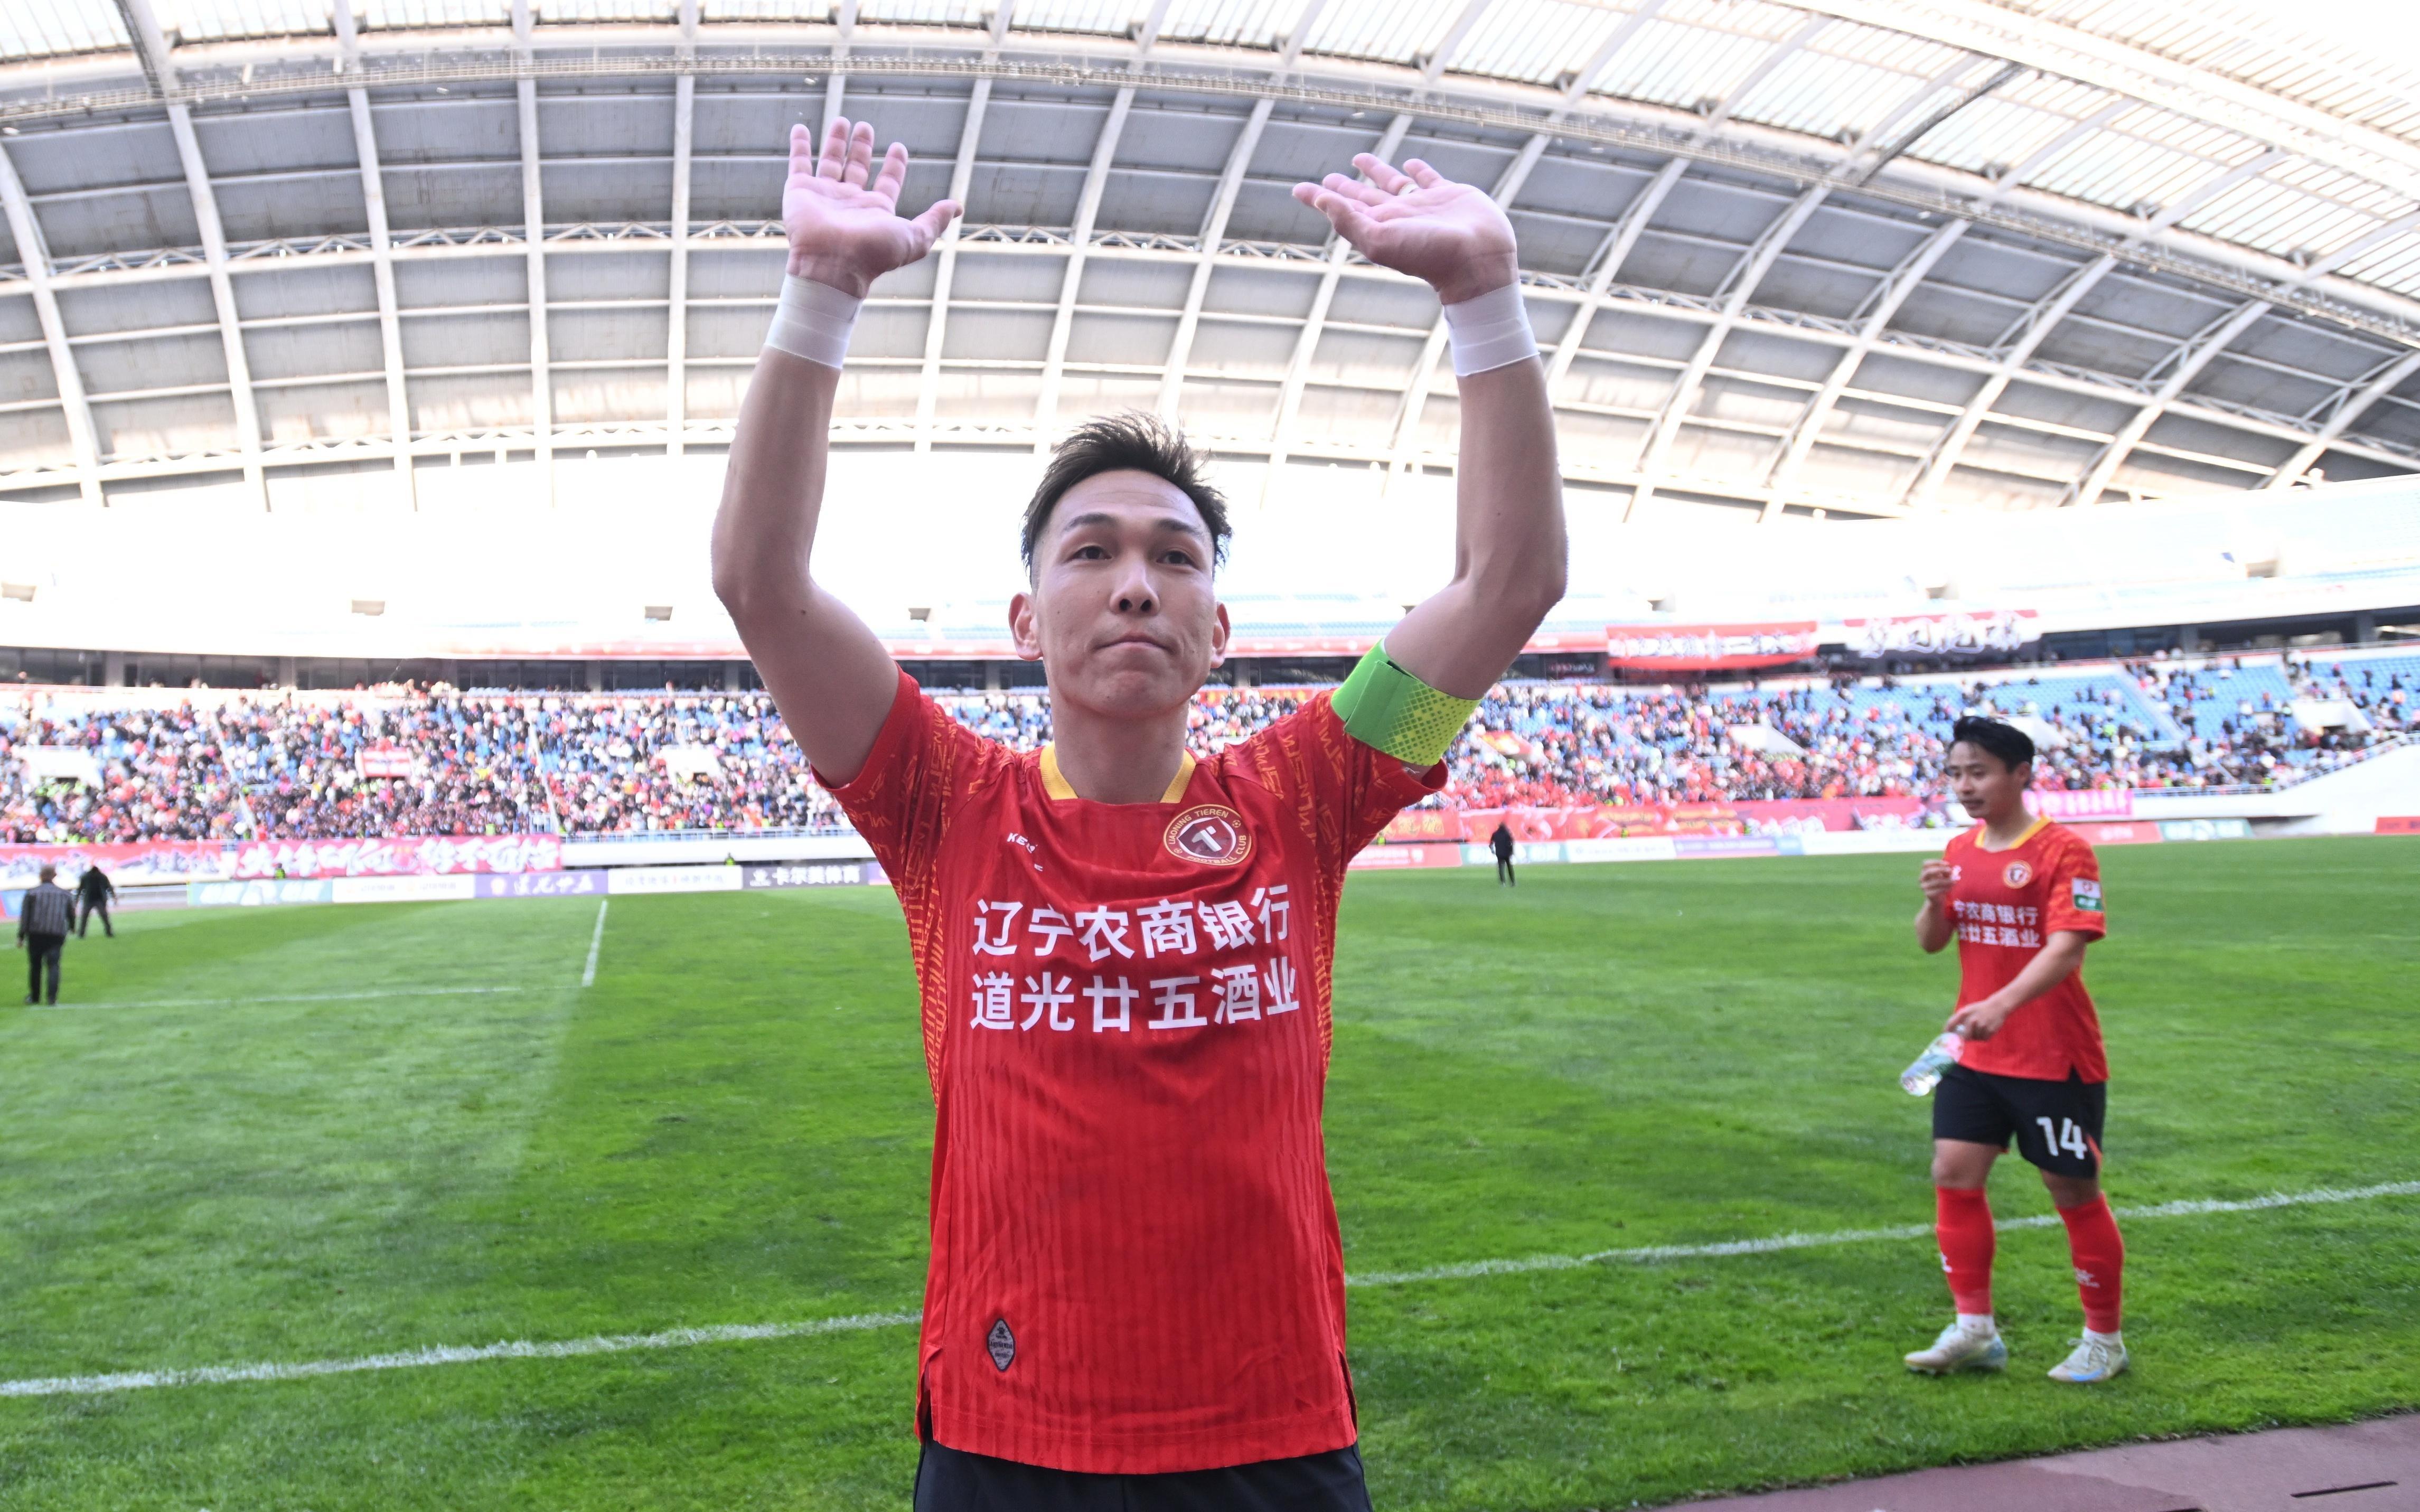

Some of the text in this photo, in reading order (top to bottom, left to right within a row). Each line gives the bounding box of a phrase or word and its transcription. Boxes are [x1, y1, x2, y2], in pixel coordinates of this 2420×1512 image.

[1168, 809, 1229, 844] LIAONING TIEREN
[1186, 834, 1246, 864] FOOTBALL CLUB
[972, 885, 1289, 962] 辽宁农商银行
[970, 956, 1299, 1032] 道光廿五酒业
[2037, 1116, 2087, 1160] 14
